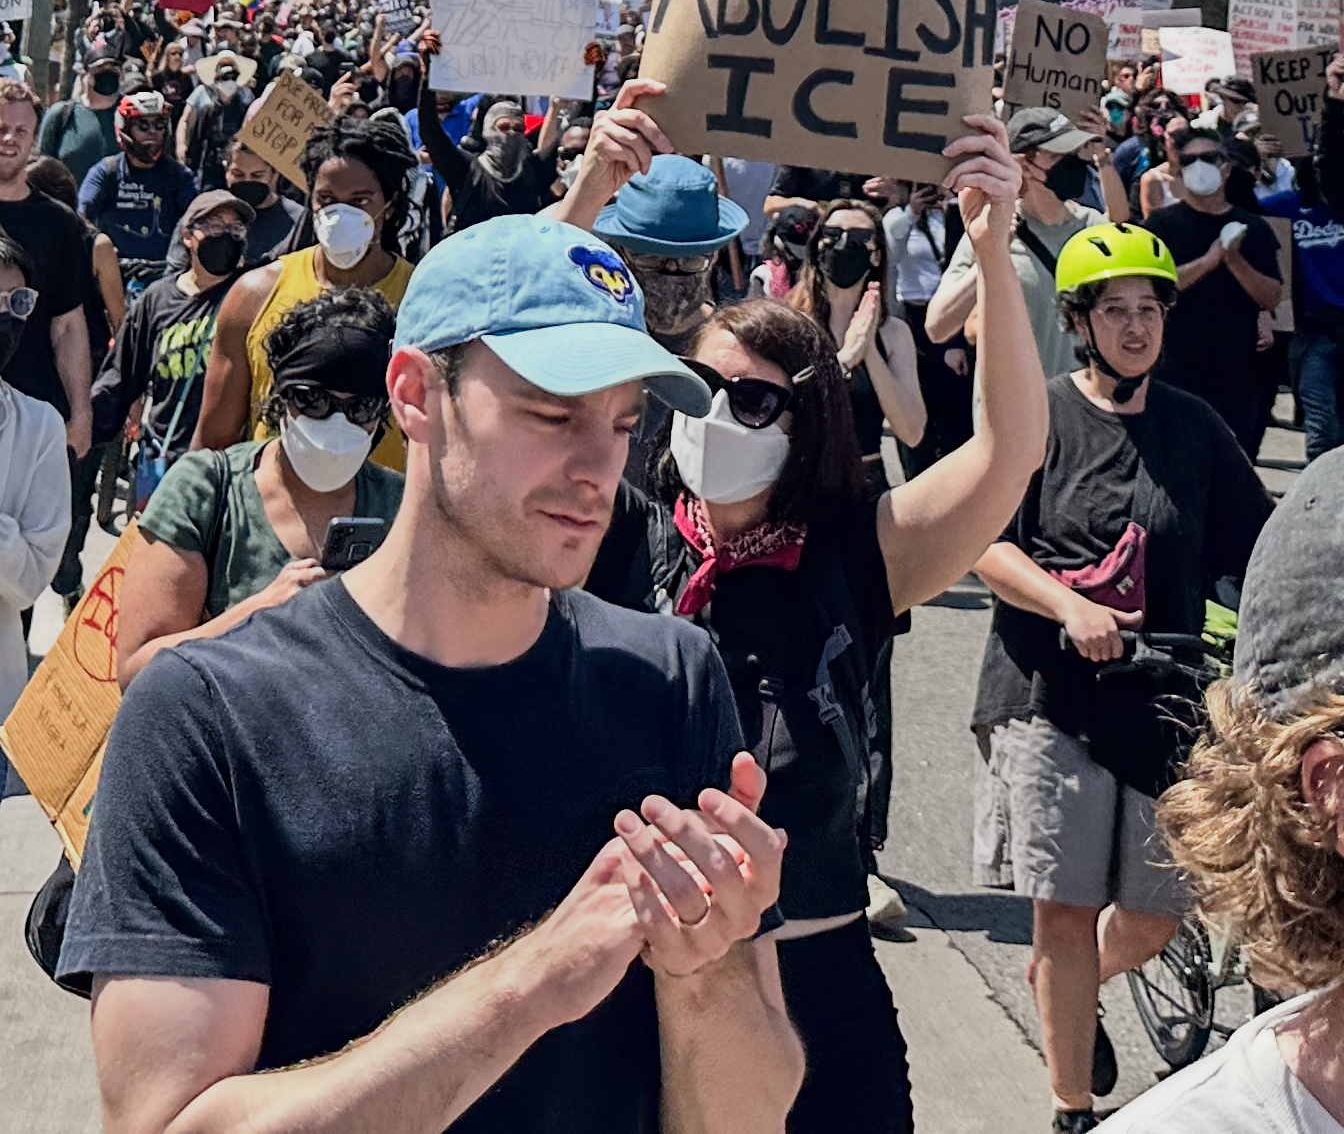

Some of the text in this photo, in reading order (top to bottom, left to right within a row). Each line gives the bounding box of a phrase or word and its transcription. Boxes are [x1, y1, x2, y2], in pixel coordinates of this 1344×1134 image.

[1232, 5, 1294, 20] ACTION TO
[1035, 14, 1091, 55] NO
[1010, 50, 1098, 94] Human
[1259, 55, 1311, 85] KEEP
[276, 97, 304, 127] FOR
[706, 54, 955, 154] ICE
